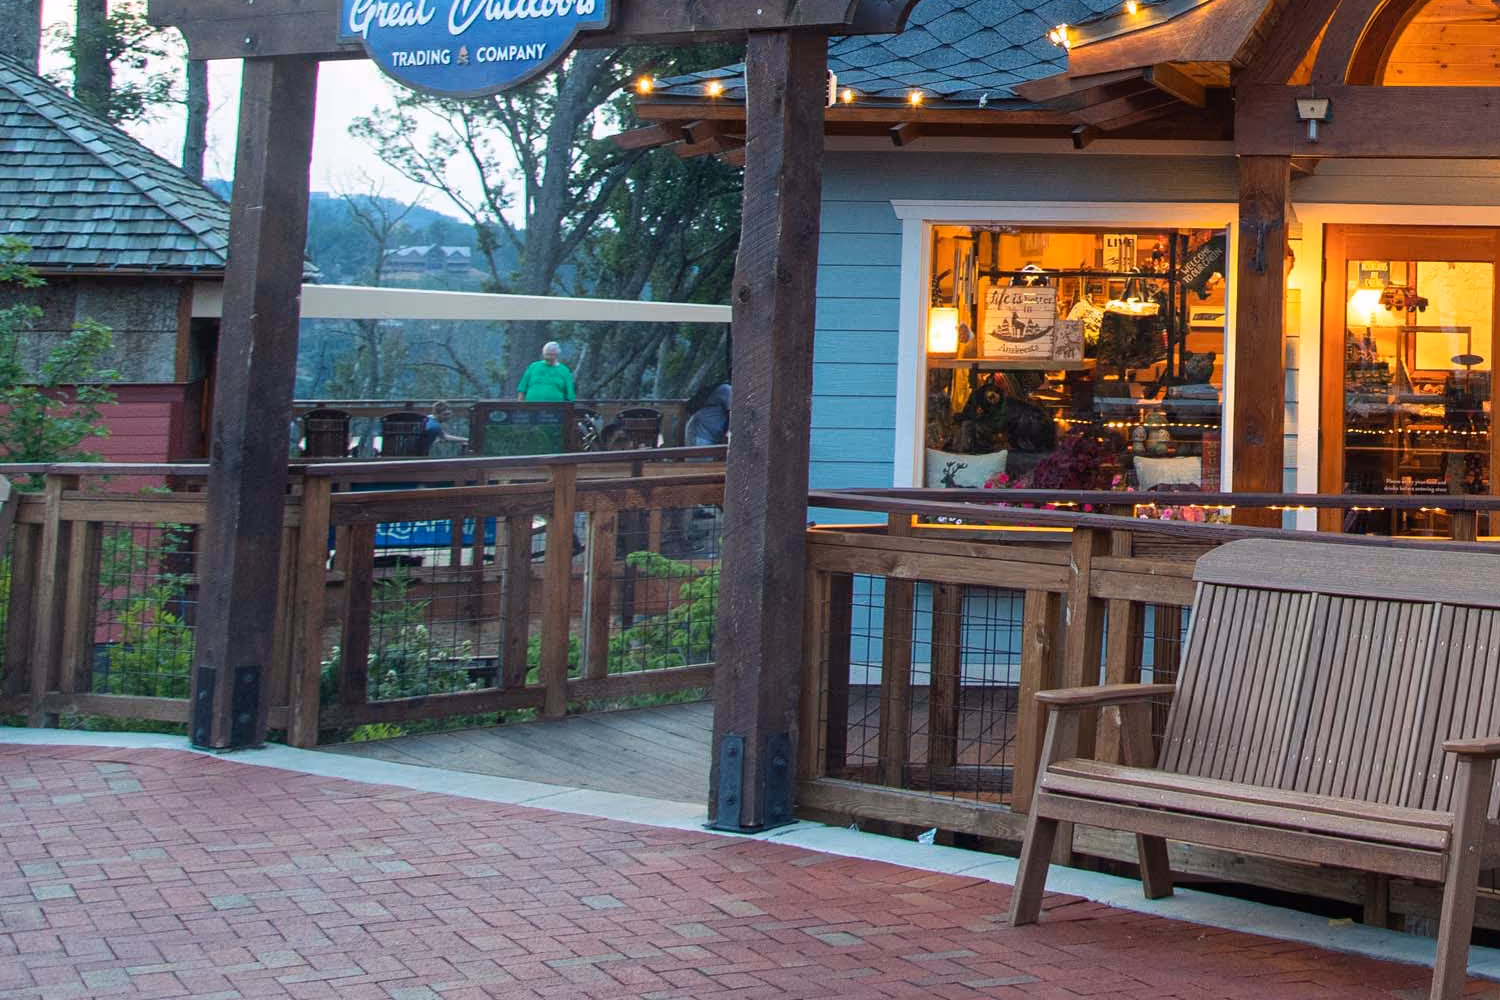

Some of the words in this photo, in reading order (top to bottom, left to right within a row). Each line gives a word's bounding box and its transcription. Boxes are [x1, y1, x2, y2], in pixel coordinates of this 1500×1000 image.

[391, 48, 451, 68] TRADING
[476, 42, 547, 64] COMPANY
[1182, 273, 1194, 285] TO
